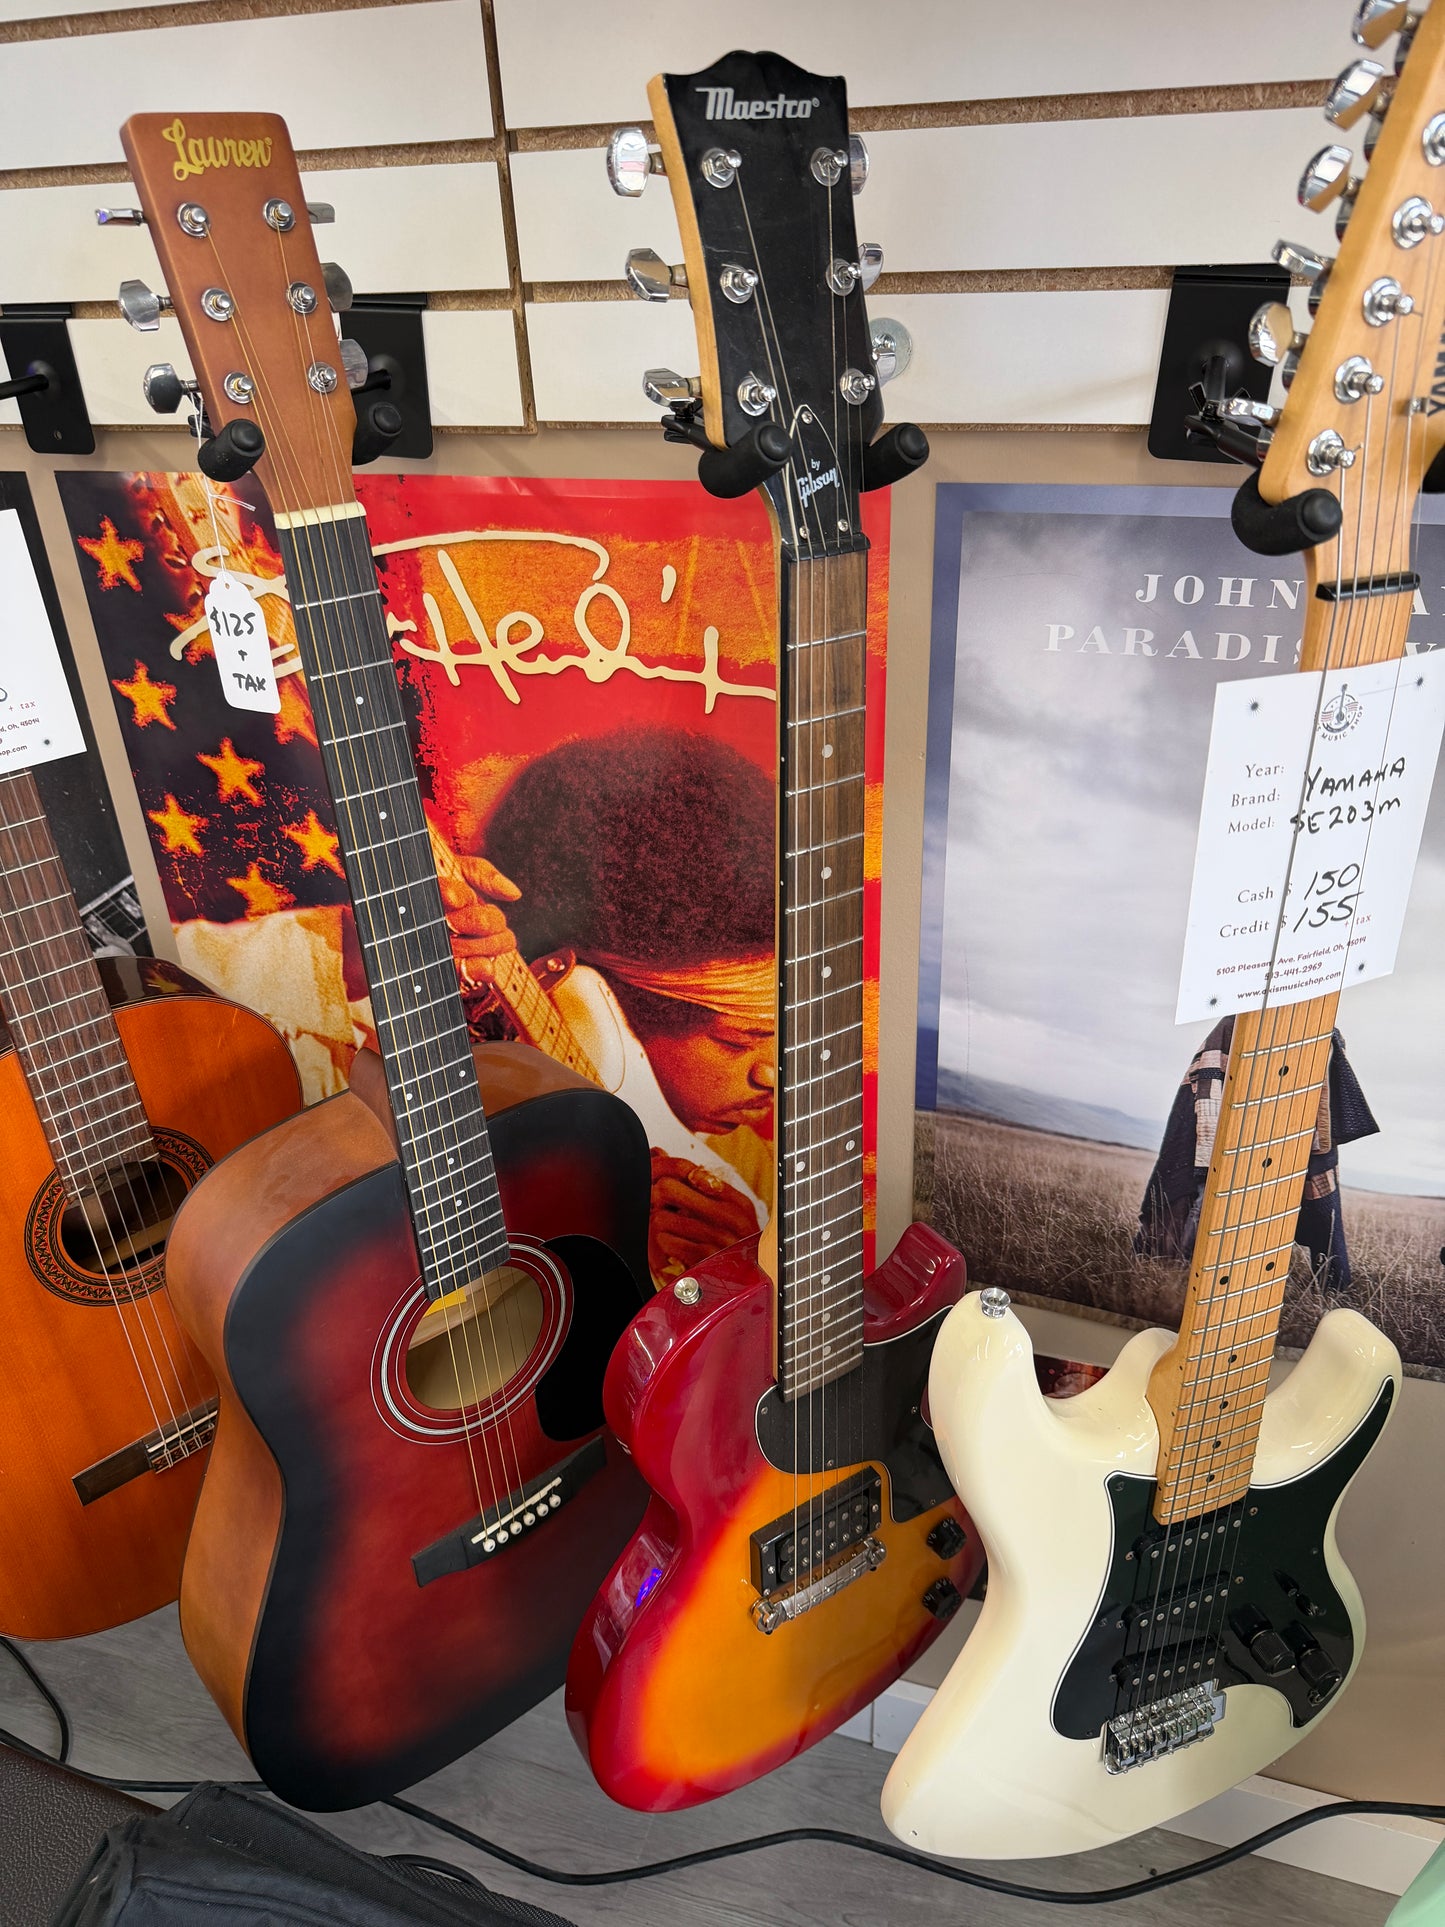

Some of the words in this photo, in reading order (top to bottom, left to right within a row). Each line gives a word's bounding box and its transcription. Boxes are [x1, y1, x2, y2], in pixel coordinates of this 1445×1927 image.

[161, 118, 272, 181] Lauren
[811, 458, 820, 470] by
[797, 467, 840, 508] Gibson
[1135, 572, 1305, 611] JOHN
[209, 606, 256, 636] $125
[232, 672, 267, 692] TAX
[20, 701, 36, 710] tax
[1245, 763, 1285, 778] Year:
[1303, 756, 1406, 802] YAMAHA
[1231, 788, 1281, 808] Brand:
[1227, 816, 1276, 835] Model:
[1237, 886, 1274, 904] Cash
[1304, 863, 1360, 900] 150
[1219, 920, 1270, 938] Credit
[1293, 891, 1364, 933] 155
[1356, 914, 1372, 926] tax
[1216, 965, 1236, 976] 5102
